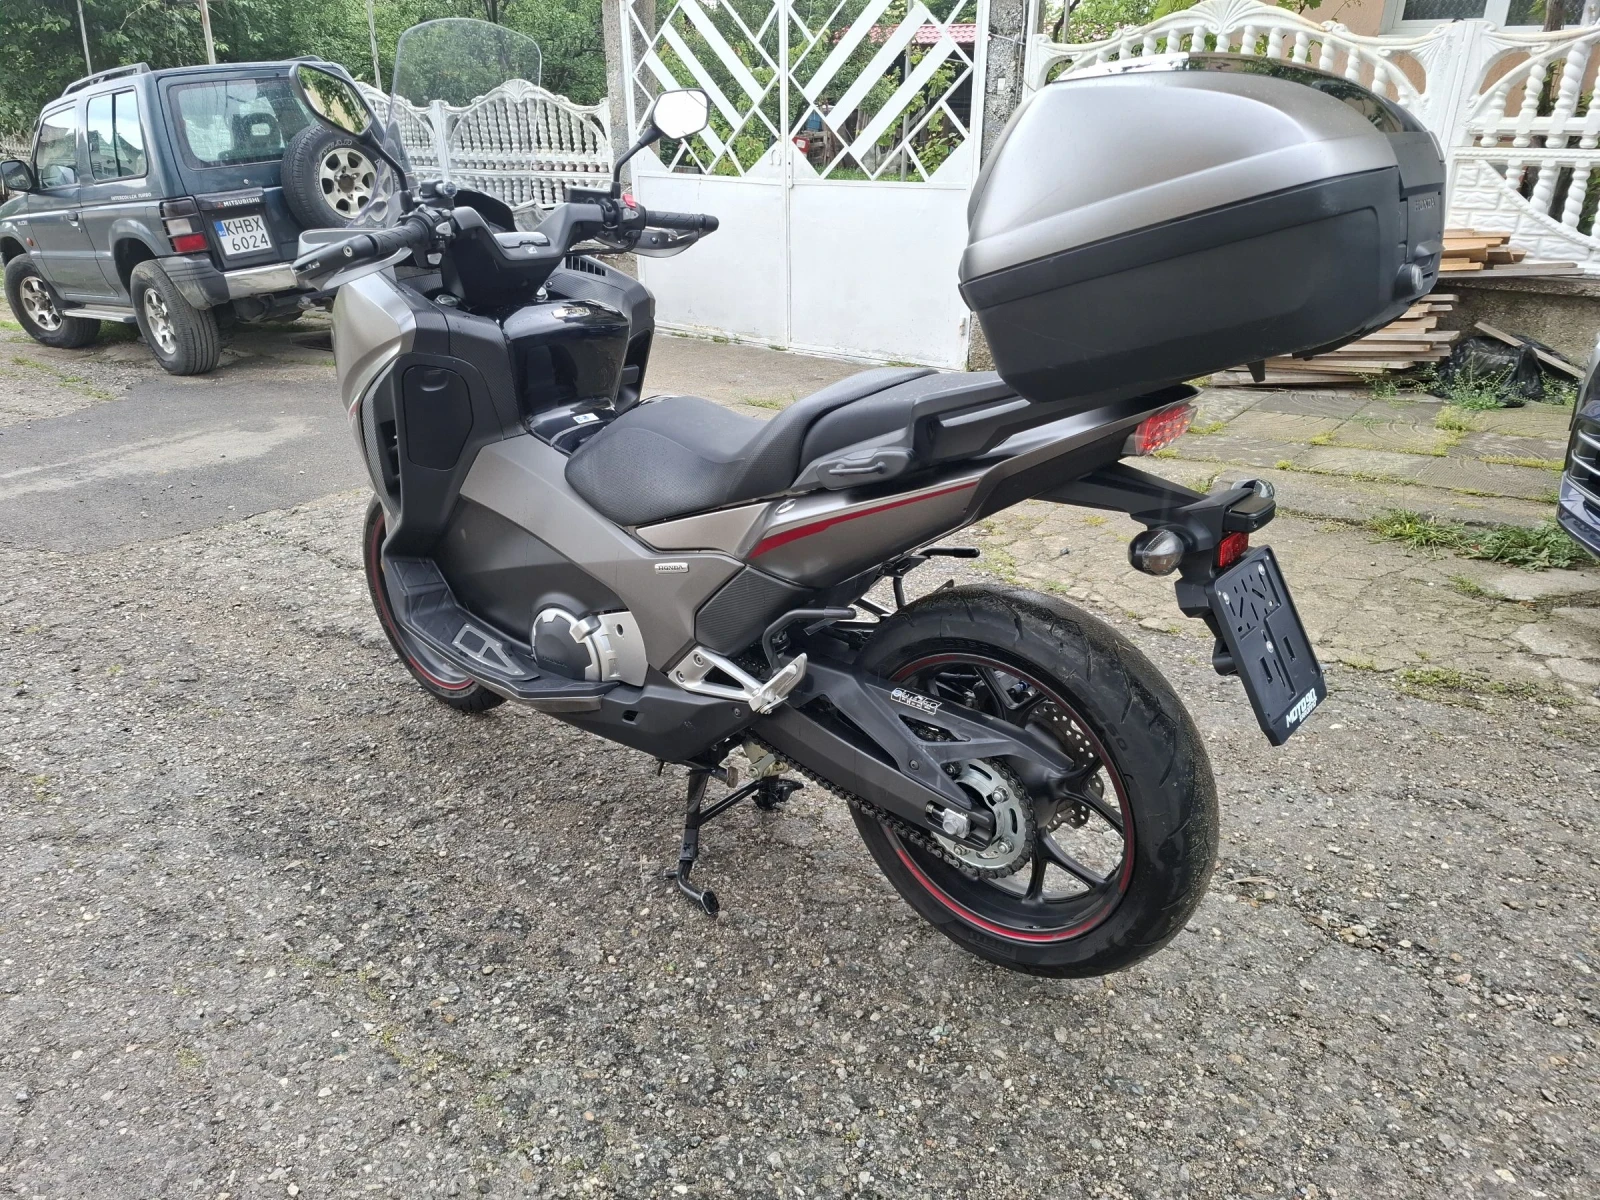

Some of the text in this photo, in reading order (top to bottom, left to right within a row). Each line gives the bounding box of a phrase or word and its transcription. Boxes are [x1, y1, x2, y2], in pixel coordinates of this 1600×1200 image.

[223, 197, 260, 207] MITSUBISHI
[223, 217, 264, 236] KHBX
[232, 234, 268, 251] 6024
